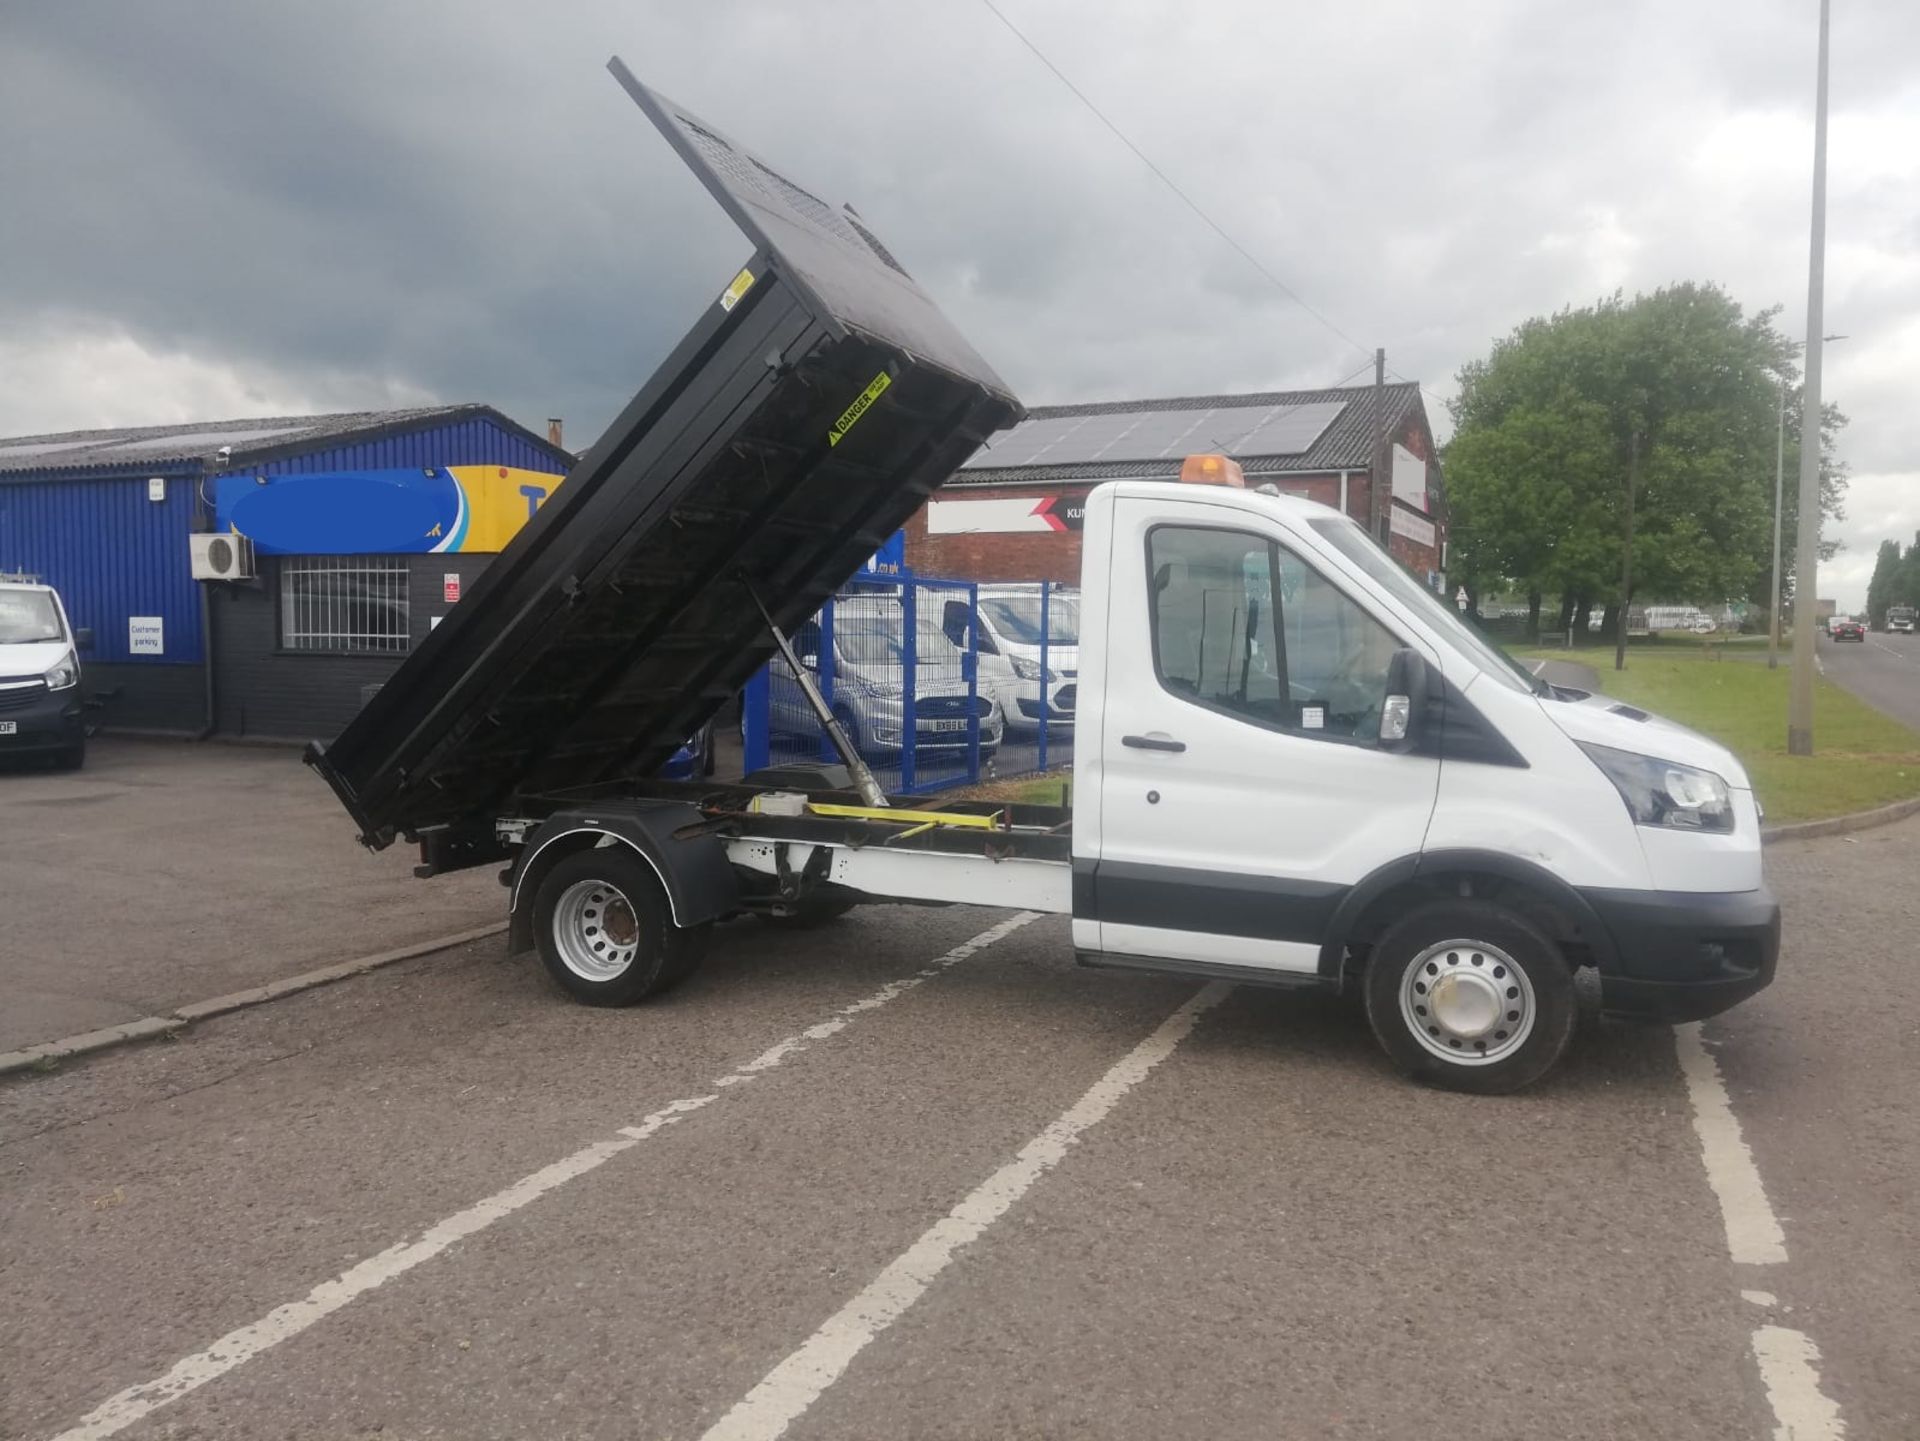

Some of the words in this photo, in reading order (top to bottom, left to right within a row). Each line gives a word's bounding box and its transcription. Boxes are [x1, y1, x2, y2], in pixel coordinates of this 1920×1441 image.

[838, 393, 872, 431] DANGER
[131, 625, 161, 634] Customer
[135, 636, 158, 647] parking
